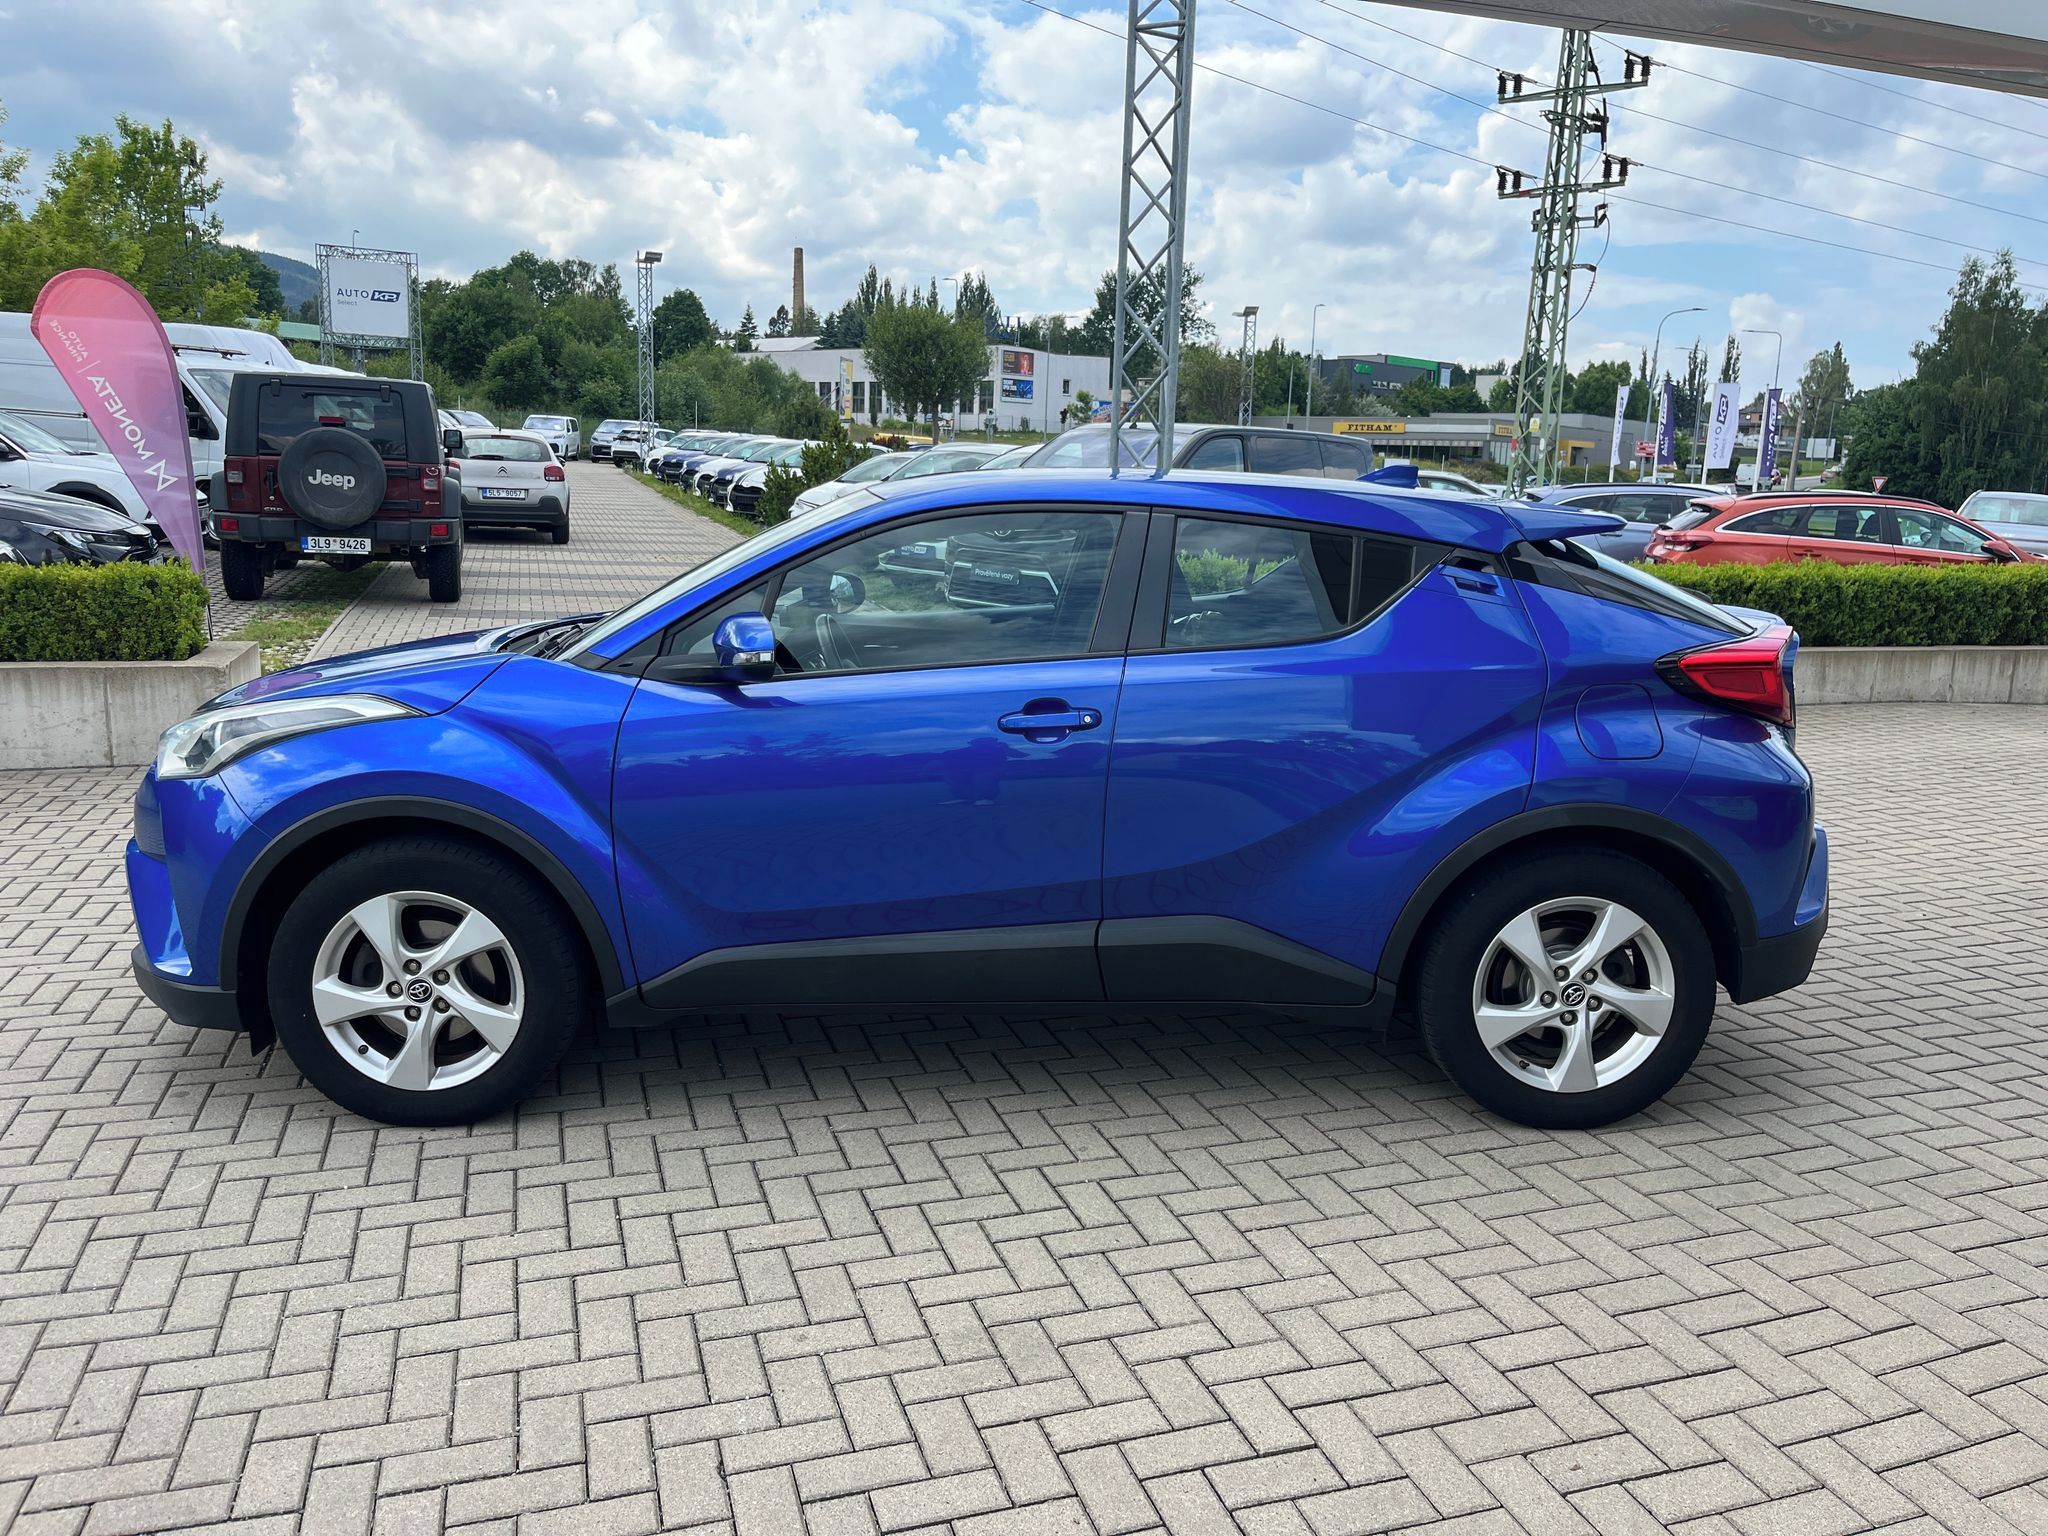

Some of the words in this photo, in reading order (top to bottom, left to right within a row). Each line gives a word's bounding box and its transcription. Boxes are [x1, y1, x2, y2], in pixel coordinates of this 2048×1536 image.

[337, 288, 369, 298] AUTO
[1347, 424, 1393, 432] FITHAM
[308, 469, 355, 489] Jeep
[310, 538, 331, 549] 3L9
[339, 540, 366, 550] 9426
